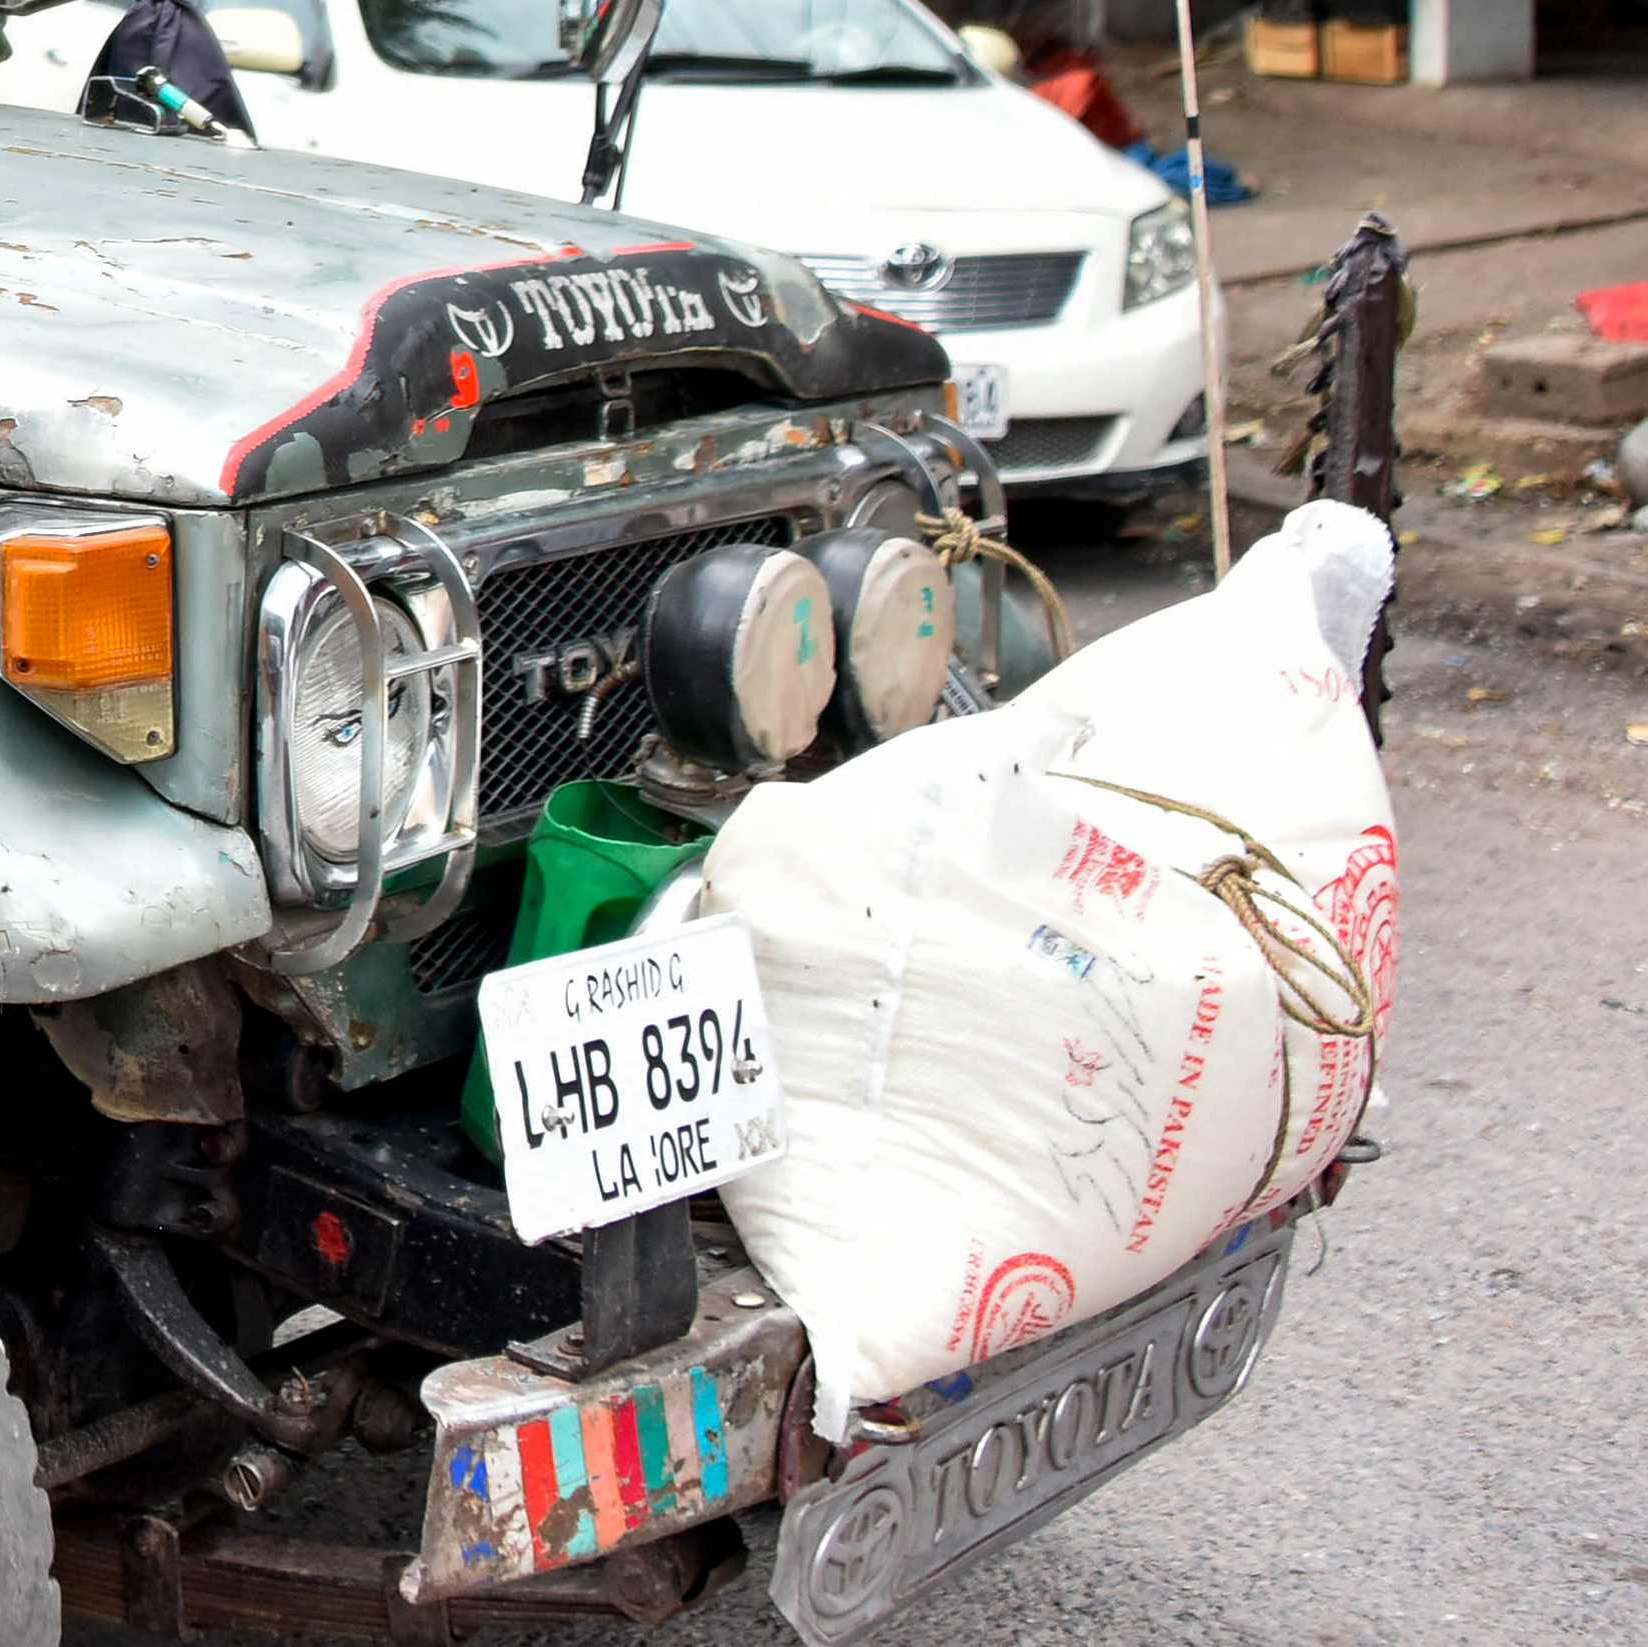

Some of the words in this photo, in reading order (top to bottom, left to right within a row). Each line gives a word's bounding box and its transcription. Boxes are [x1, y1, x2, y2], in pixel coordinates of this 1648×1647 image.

[513, 623, 641, 705] TOY
[586, 958, 662, 1014] RASHID
[514, 1038, 619, 1149] LHB
[642, 998, 757, 1111] 8394
[1176, 1052, 1206, 1091] IN
[1295, 1034, 1340, 1156] EFINED
[1125, 1095, 1195, 1255] PAKISTAN
[932, 1340, 1155, 1543] TOYOTA
